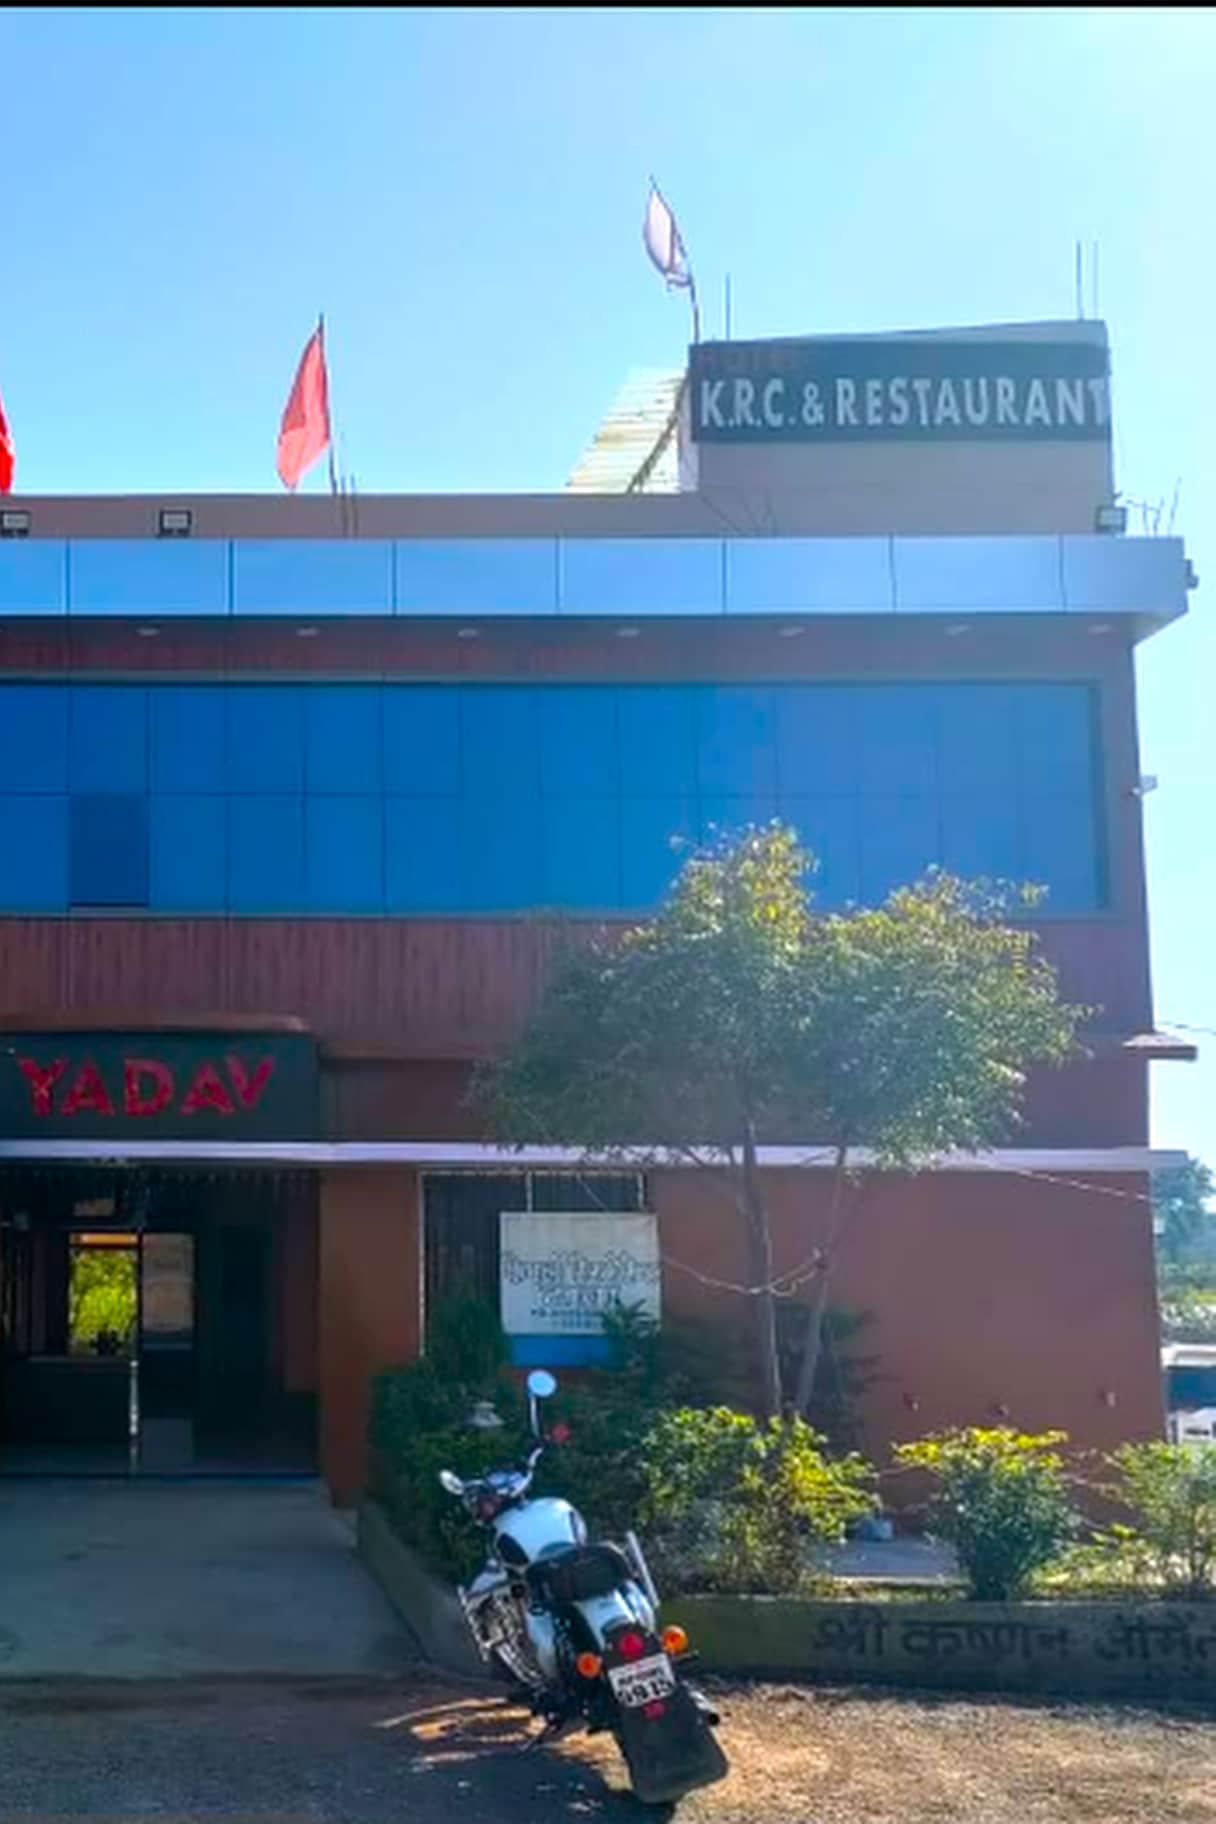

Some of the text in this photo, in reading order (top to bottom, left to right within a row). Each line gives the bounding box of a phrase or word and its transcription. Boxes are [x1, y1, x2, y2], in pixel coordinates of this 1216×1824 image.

[802, 382, 825, 425] &
[835, 376, 1109, 427] RESTAURANT
[17, 1054, 275, 1117] YADAV
